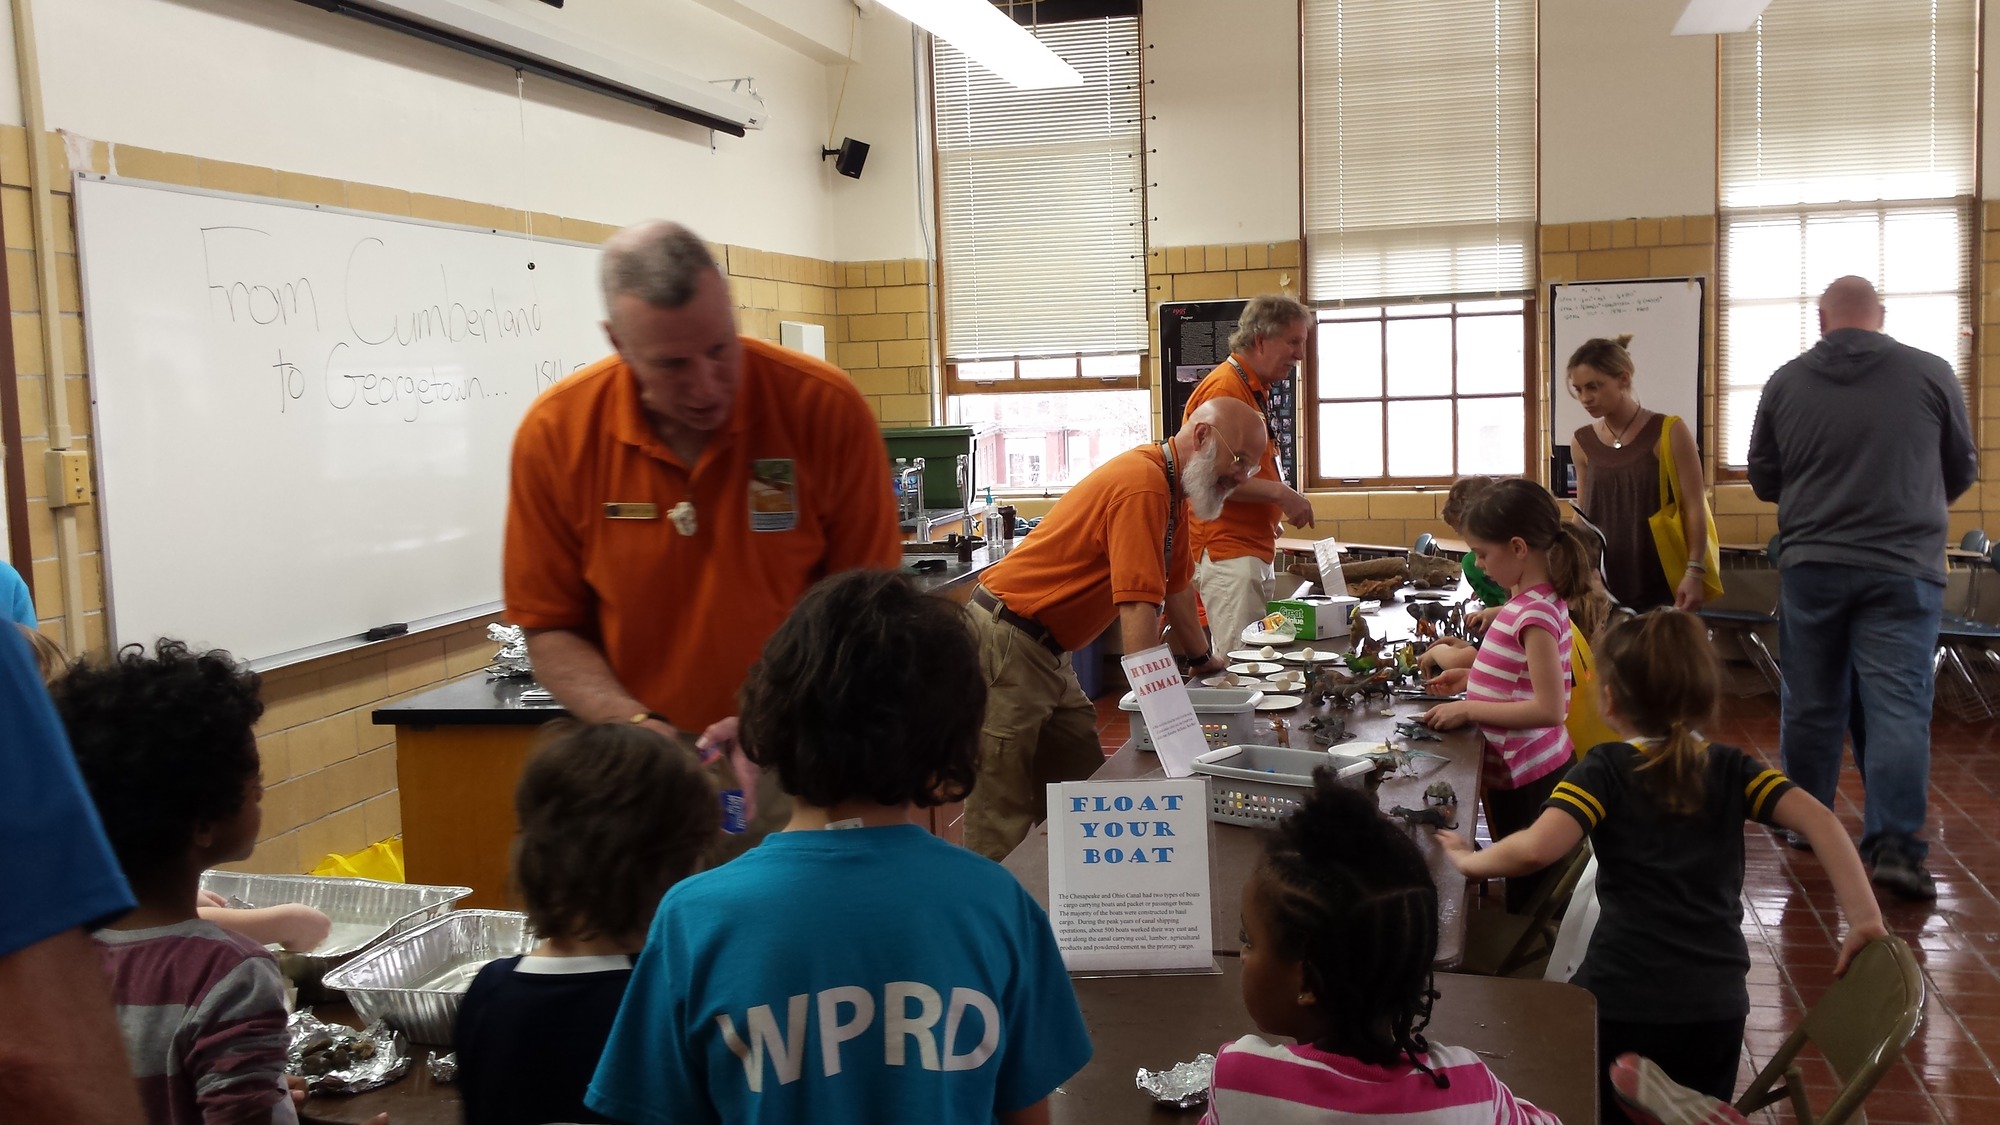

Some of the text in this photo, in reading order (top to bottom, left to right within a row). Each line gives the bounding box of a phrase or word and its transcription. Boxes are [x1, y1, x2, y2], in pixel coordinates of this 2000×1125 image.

[200, 226, 542, 346] From Cumberland
[272, 348, 306, 414] to
[325, 342, 507, 422] Georgetown...
[1130, 657, 1172, 678] HYBRID
[1139, 675, 1180, 696] ANIMAL
[1070, 795, 1183, 812] FLOAT
[1080, 821, 1176, 838] YOUR
[1082, 847, 1174, 864] BOAT
[716, 981, 1000, 1092] WPRD
